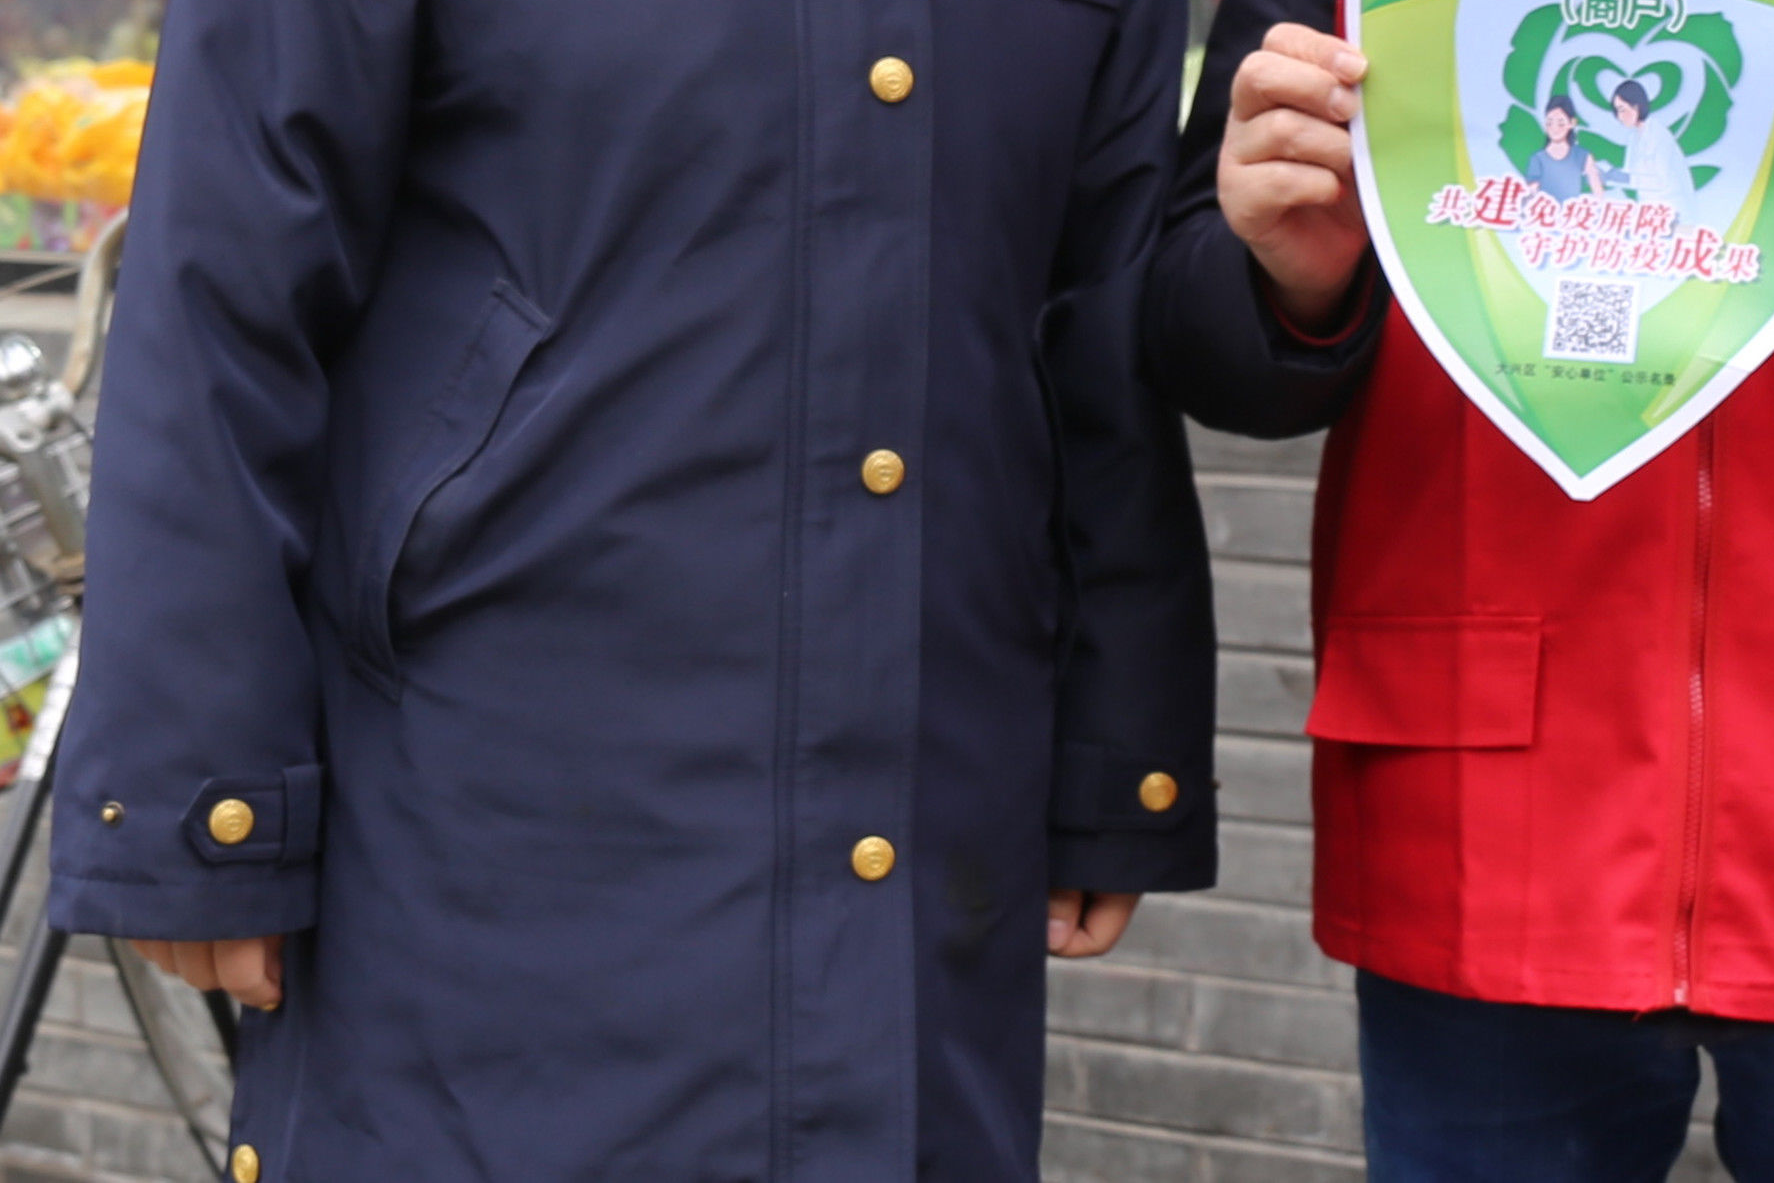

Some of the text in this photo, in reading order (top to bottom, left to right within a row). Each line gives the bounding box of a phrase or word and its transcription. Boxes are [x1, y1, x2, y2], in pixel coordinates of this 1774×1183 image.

[1430, 175, 1673, 236] 共建免疫屏障
[1521, 227, 1759, 278] 守护防疫成果
